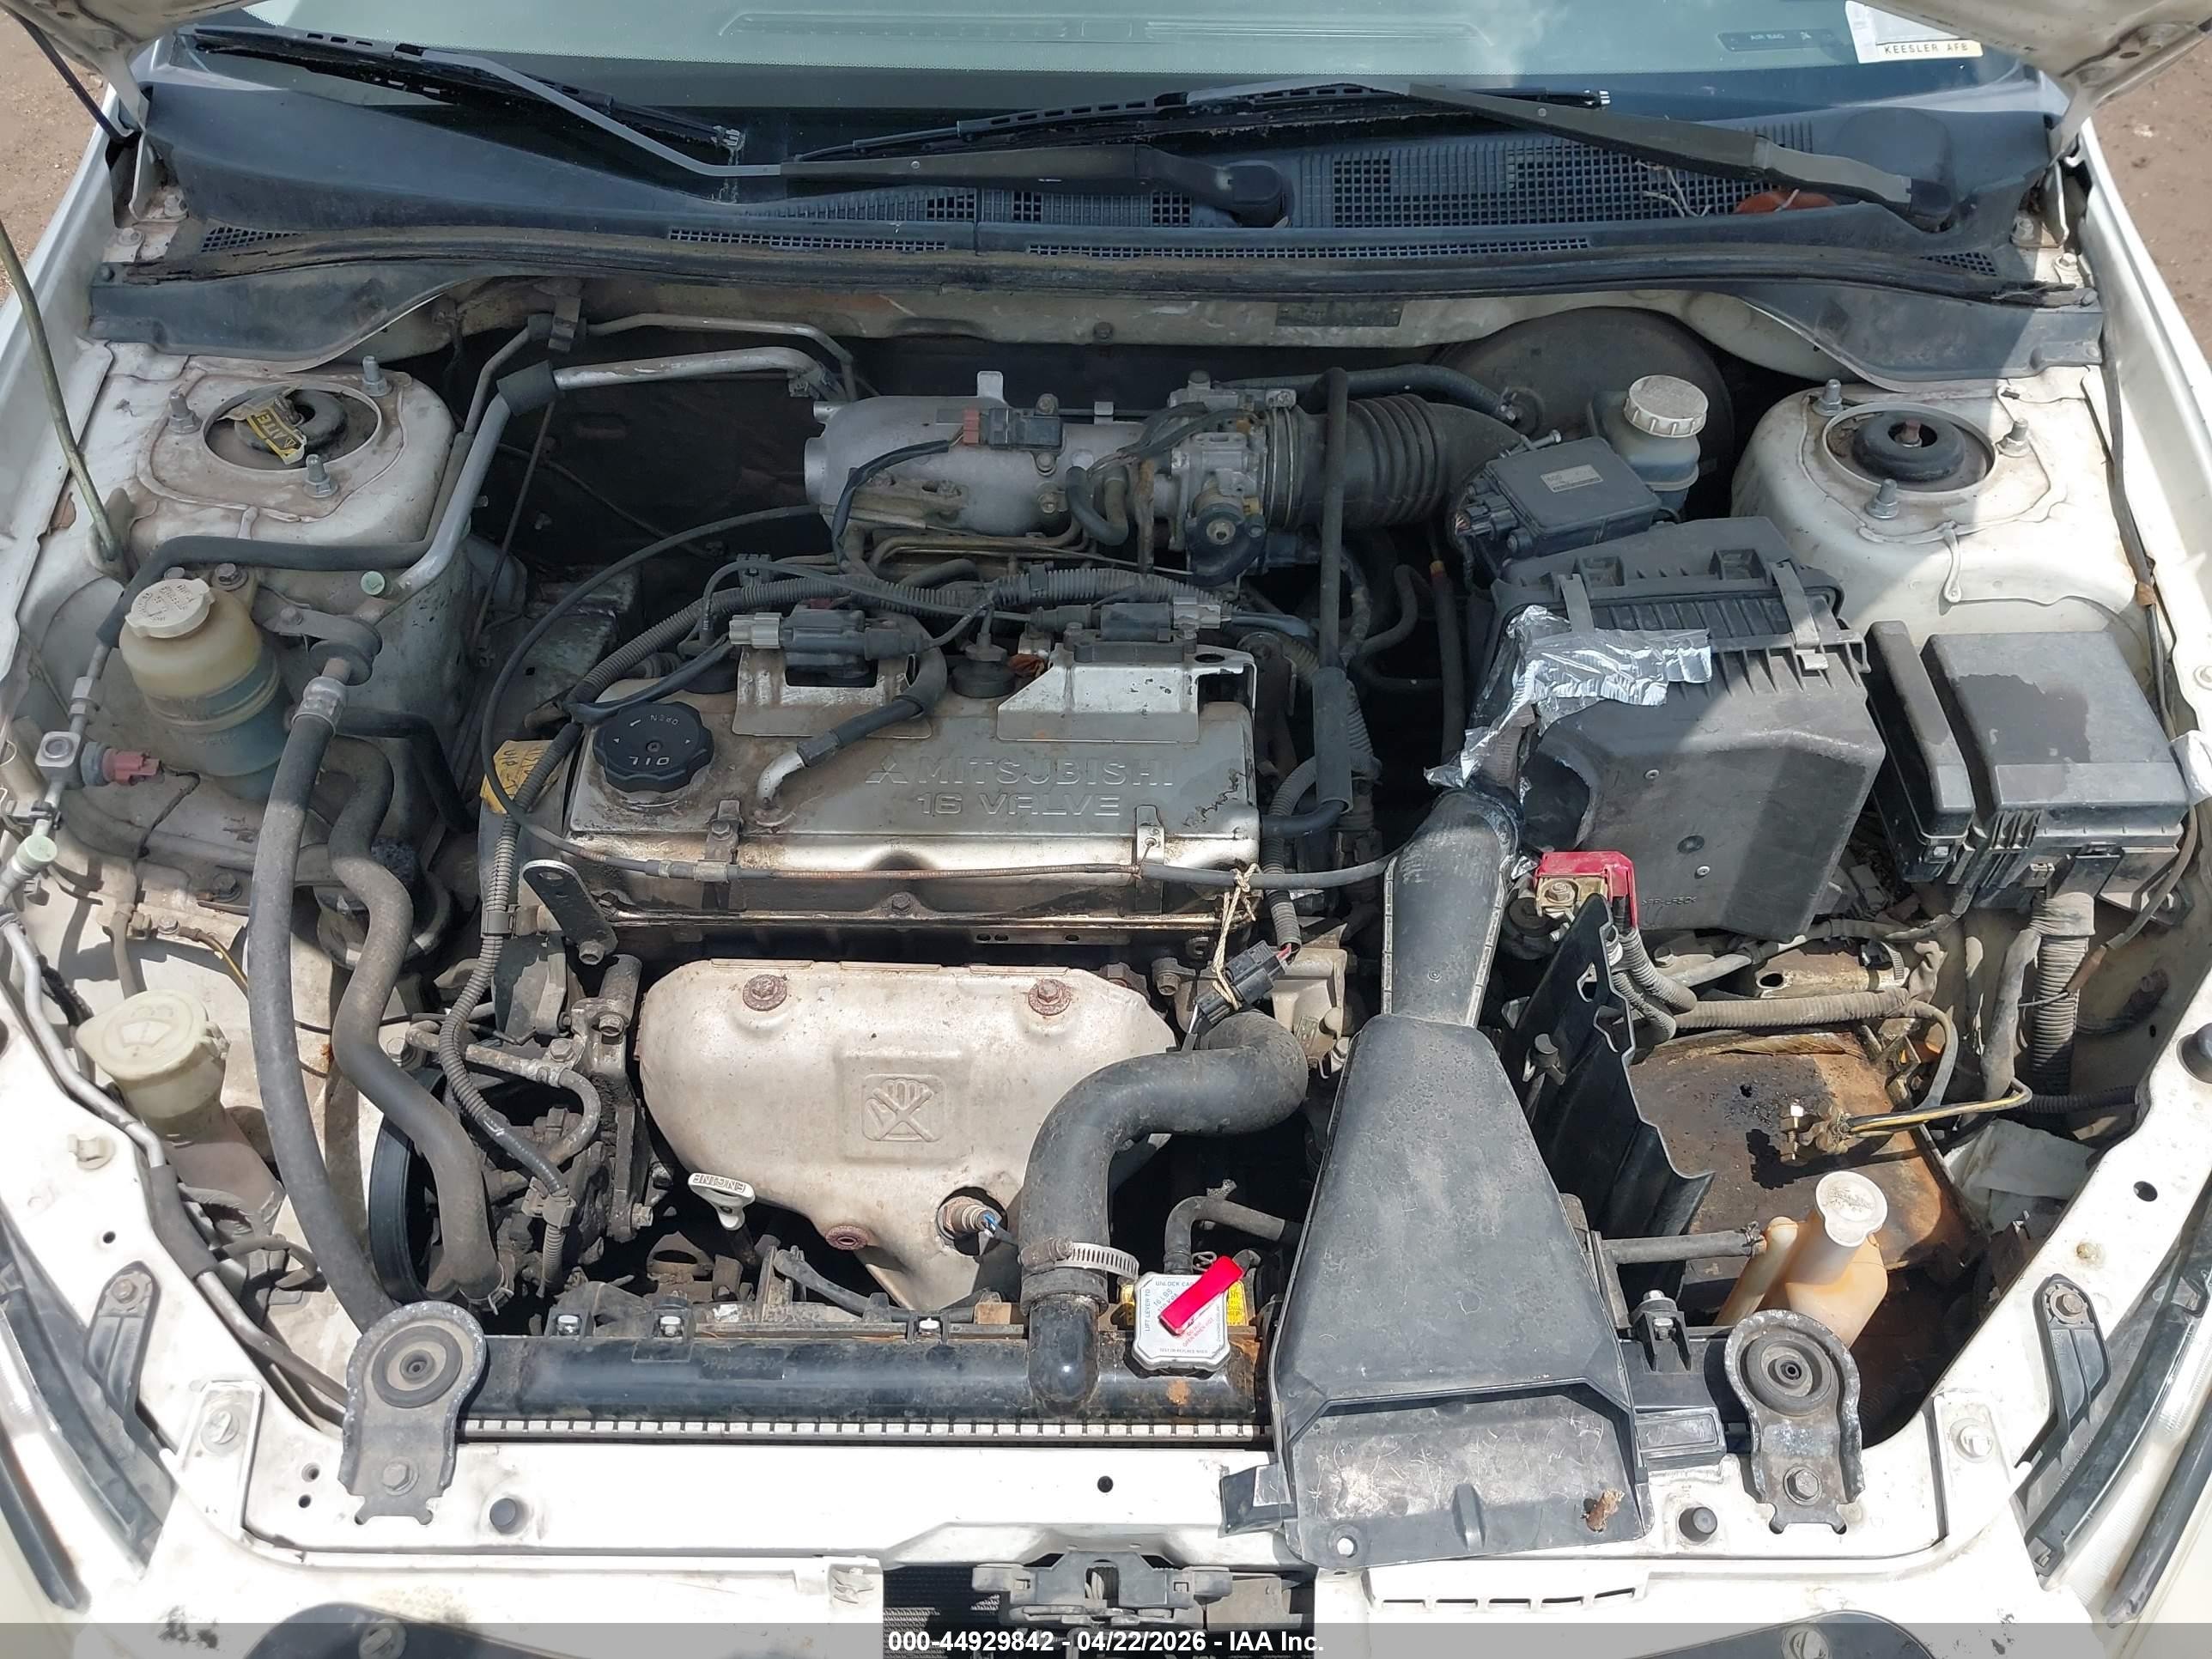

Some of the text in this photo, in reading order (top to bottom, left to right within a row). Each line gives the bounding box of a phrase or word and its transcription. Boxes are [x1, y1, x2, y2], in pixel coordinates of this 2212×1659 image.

[1884, 43, 1969, 55] KEESLER AFB
[650, 714, 679, 726] OPEN
[918, 757, 1174, 786] MITSUBISHI
[916, 791, 1121, 817] 16 VALVE
[693, 1174, 746, 1193] ENGINE
[1145, 1288, 1151, 1297] TO
